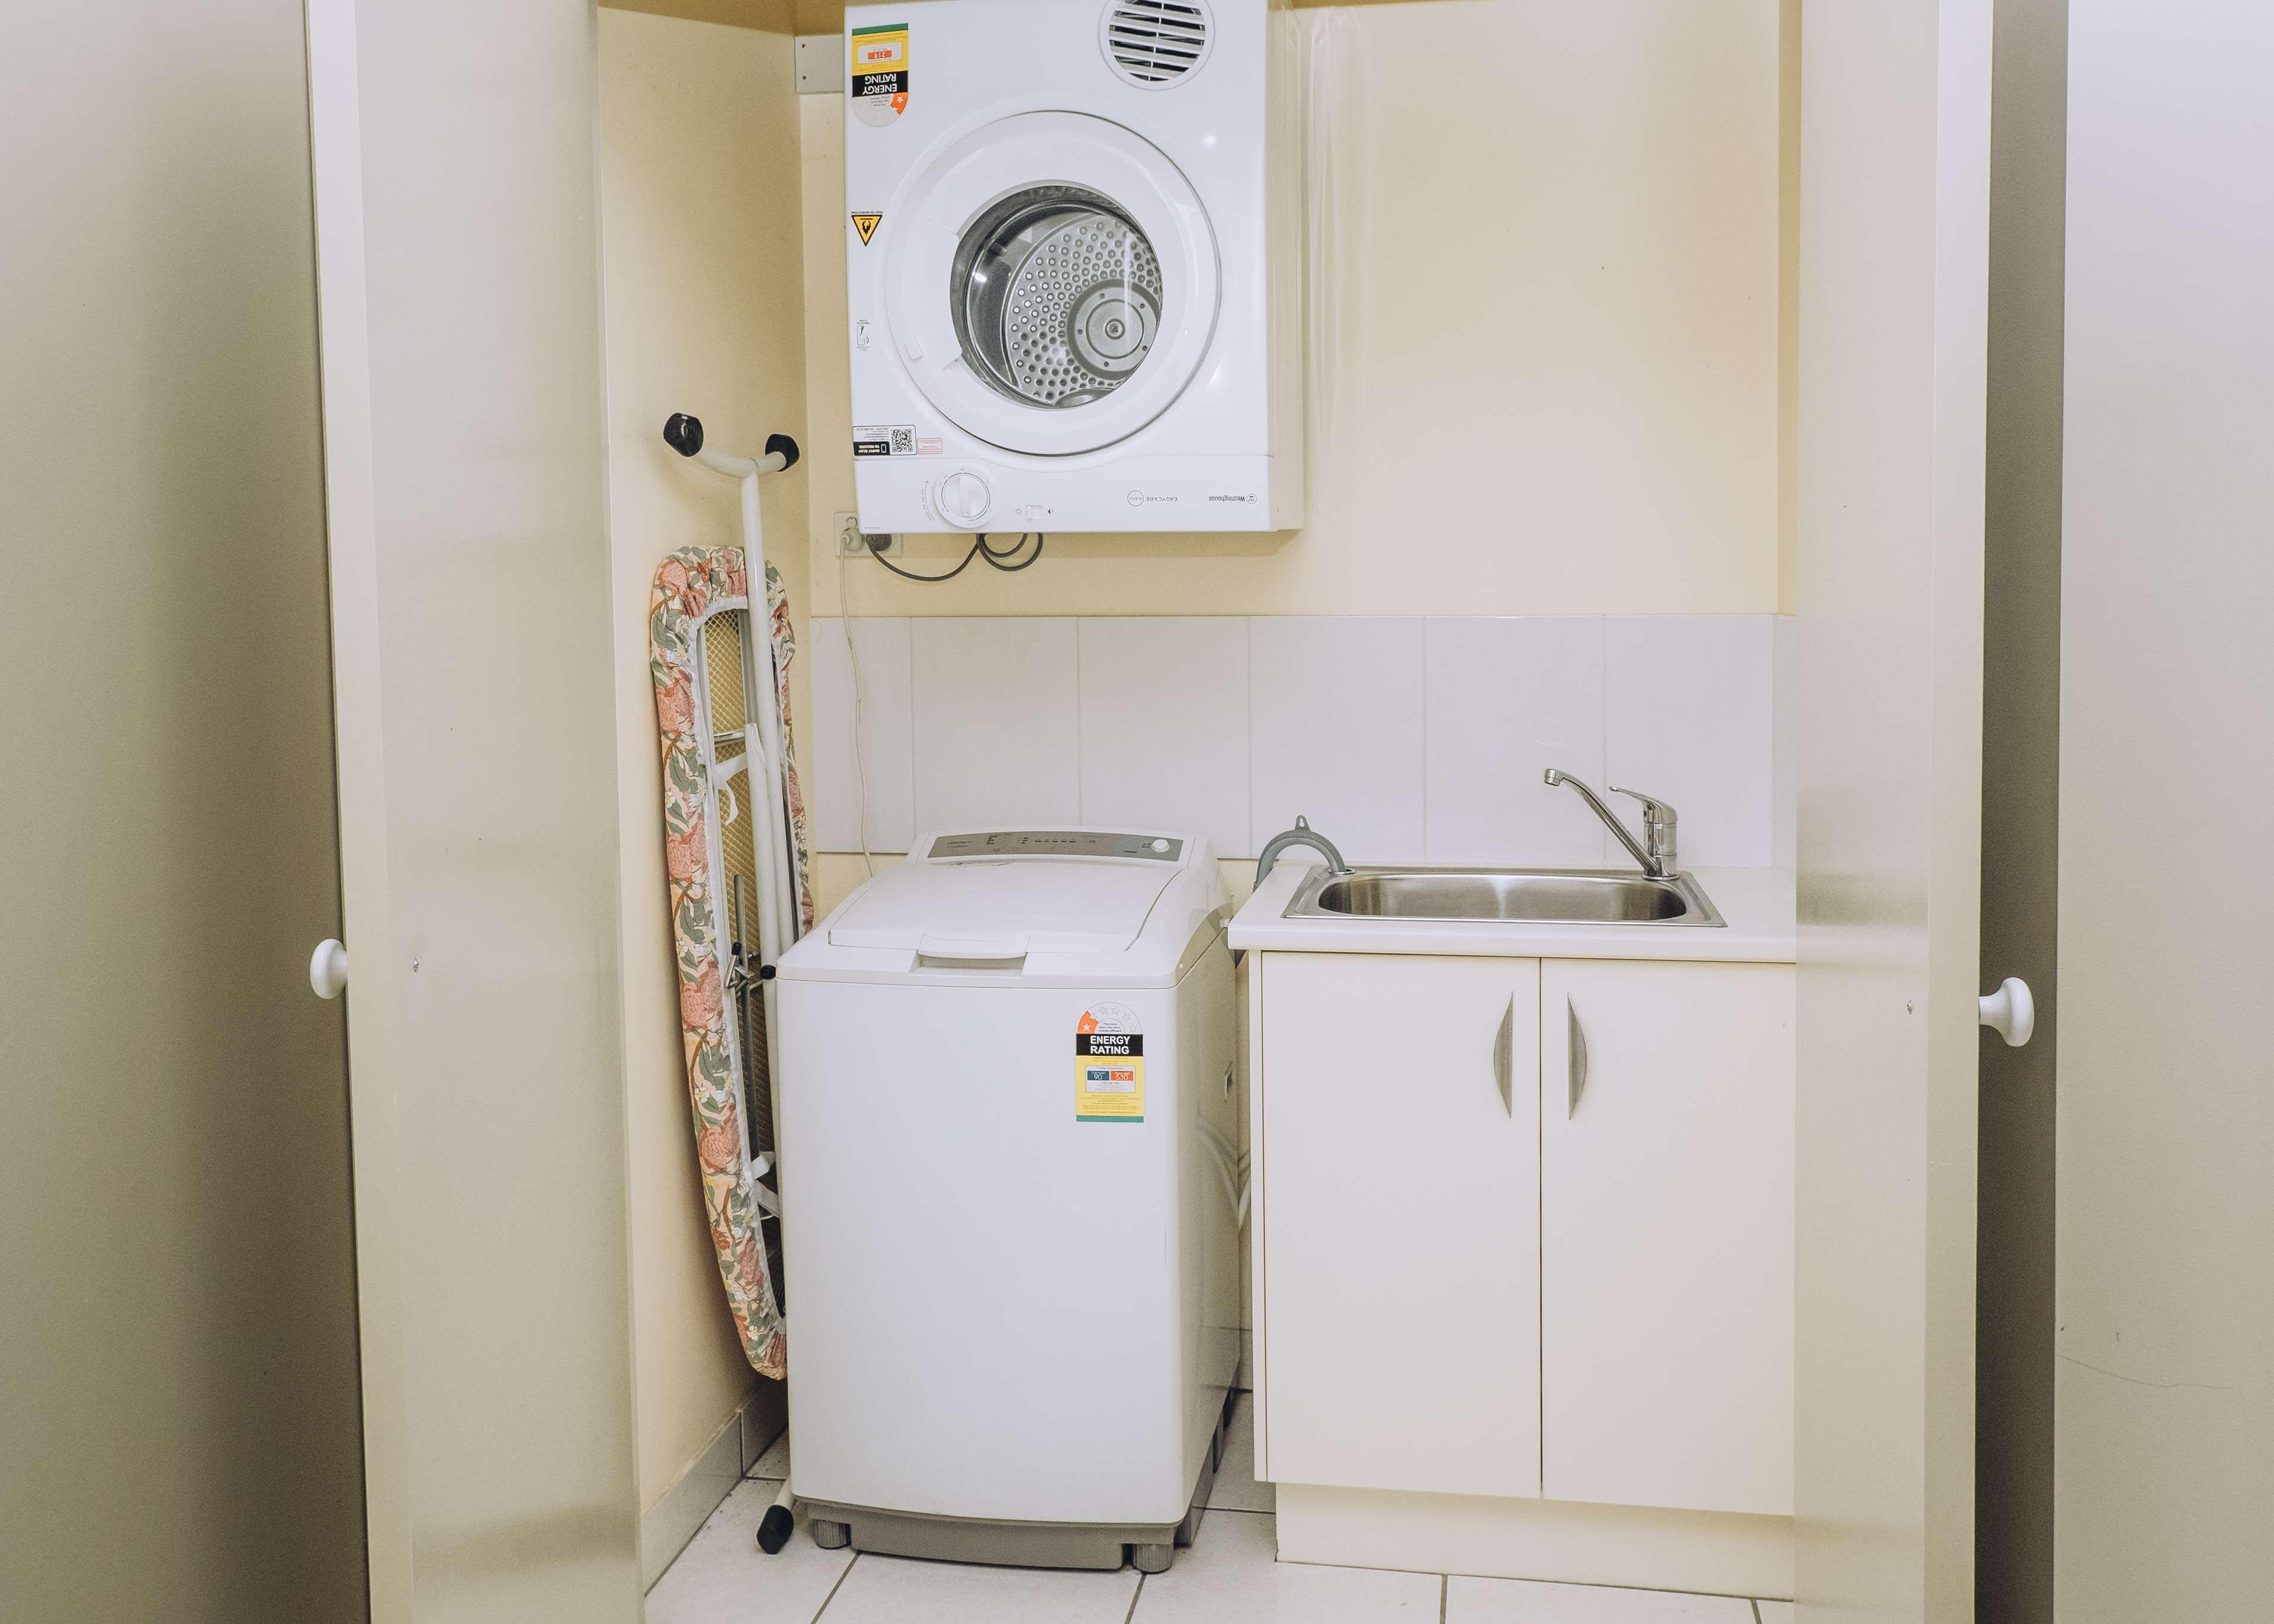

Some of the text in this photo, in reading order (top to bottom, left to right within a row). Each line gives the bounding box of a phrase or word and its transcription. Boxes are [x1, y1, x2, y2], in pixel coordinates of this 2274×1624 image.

[865, 73, 896, 85] RATING
[862, 84, 897, 95] ENERGY
[1090, 1035, 1130, 1045] ENERGY
[1090, 1045, 1130, 1054] RATING
